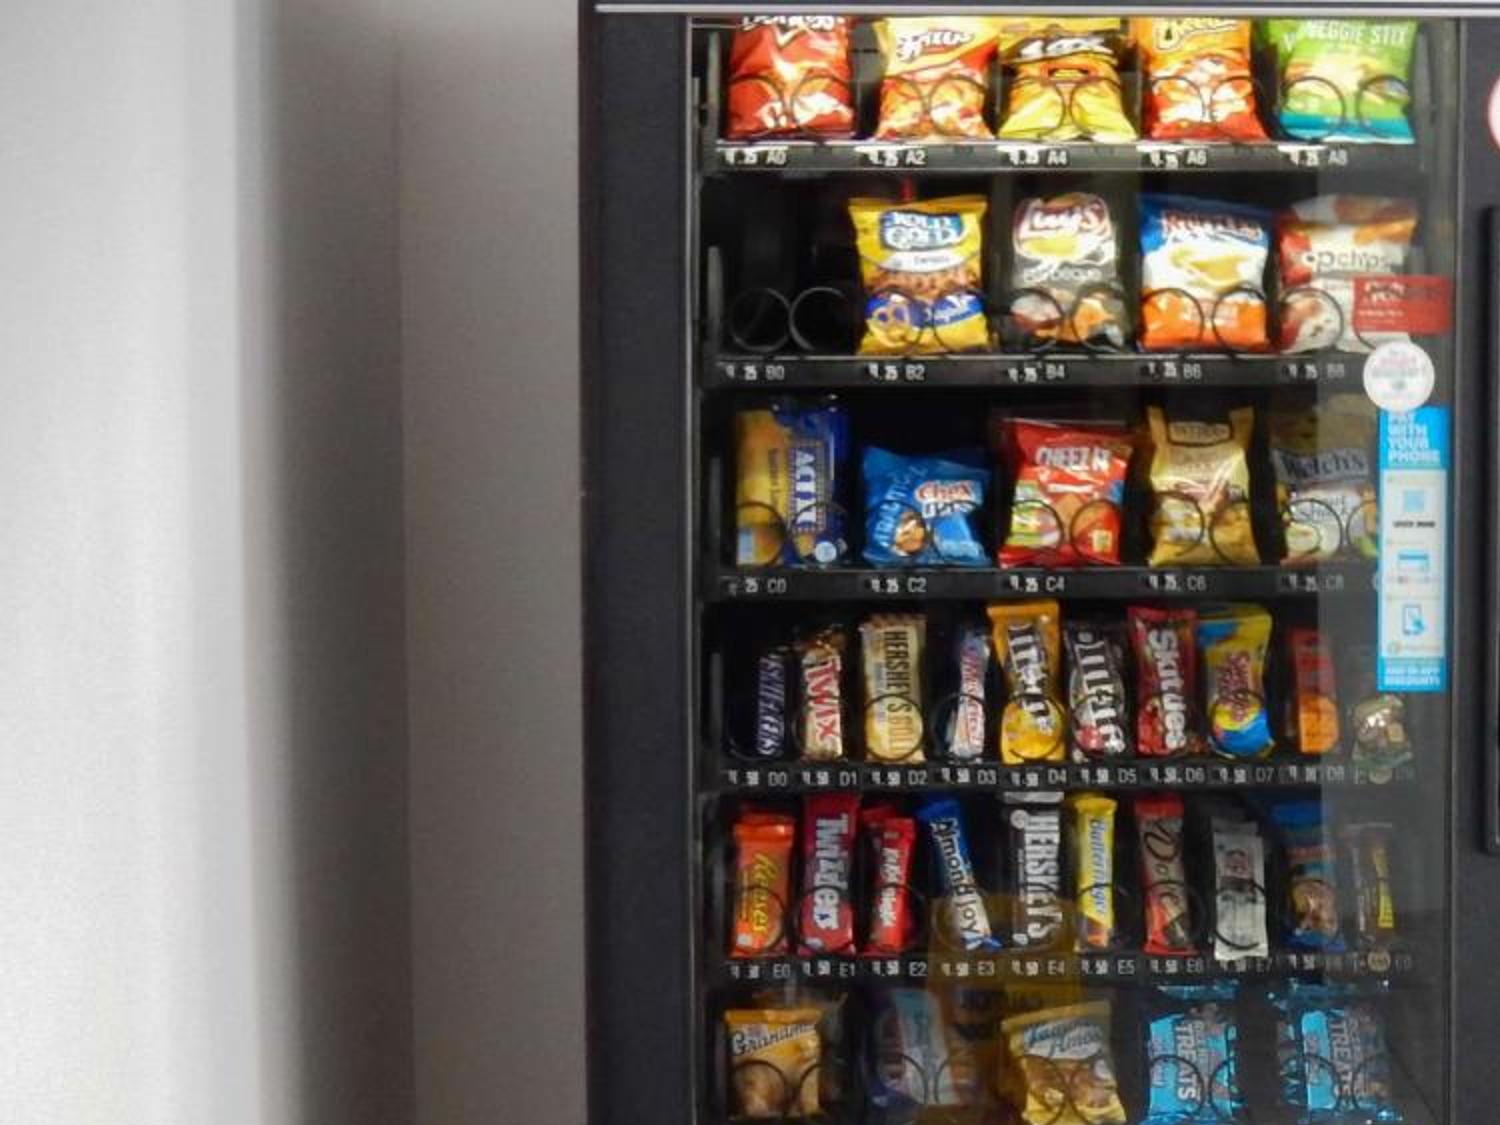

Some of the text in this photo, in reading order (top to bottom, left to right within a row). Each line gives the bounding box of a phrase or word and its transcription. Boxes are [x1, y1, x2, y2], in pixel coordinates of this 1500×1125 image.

[906, 150, 926, 165] A2
[1048, 151, 1067, 165] A4
[907, 577, 927, 593] C2
[1046, 577, 1065, 592] C4
[803, 658, 842, 742] TWIX
[1148, 628, 1189, 750] Skittles
[1023, 810, 1063, 939] HERSHEY'S
[909, 962, 928, 977] E2
[1175, 1022, 1199, 1101] TREATS
[1329, 1020, 1354, 1098] TREATS
